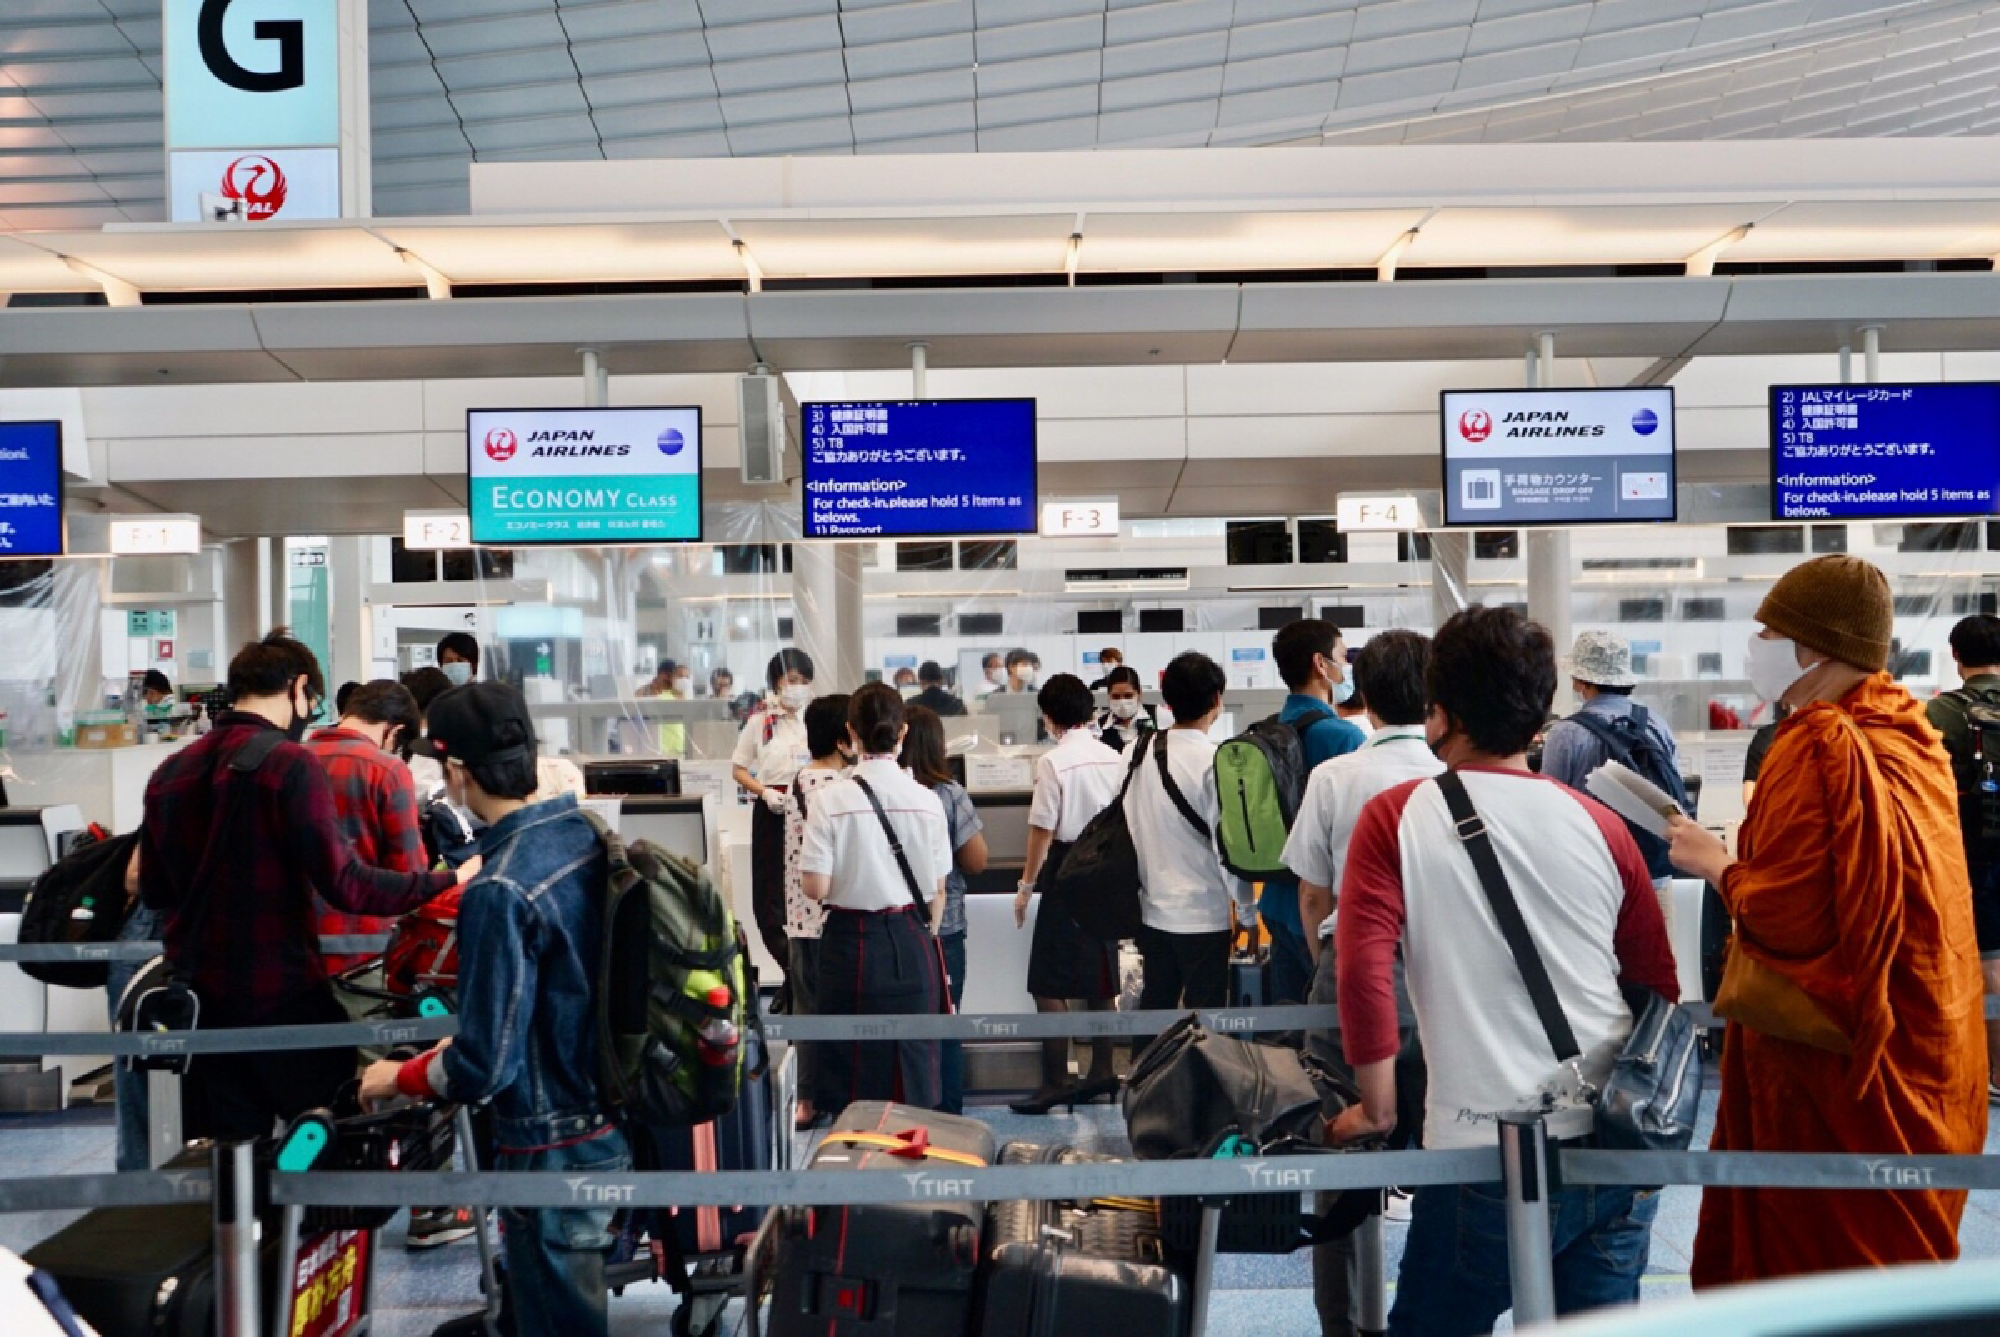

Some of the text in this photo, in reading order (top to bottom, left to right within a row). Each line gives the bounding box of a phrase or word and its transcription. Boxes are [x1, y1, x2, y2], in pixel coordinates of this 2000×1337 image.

[197, 0, 304, 92] G
[1502, 411, 1570, 423] JAPAN
[527, 430, 595, 442] JAPAN
[1507, 425, 1606, 438] AIRLINES
[531, 445, 632, 457] AIRLINES
[806, 478, 907, 492] <Information>
[1777, 472, 1877, 487] <Information>
[812, 497, 833, 508] For
[930, 494, 959, 507] hold
[962, 495, 969, 507] 5
[972, 494, 1005, 507] items
[1008, 496, 1022, 506] as
[1785, 491, 1804, 503] For
[1900, 488, 1928, 501] hold
[1931, 488, 1938, 500] 5
[1941, 488, 1974, 500] items
[1977, 490, 1990, 500] as
[813, 511, 861, 523] belows.
[1360, 505, 1398, 523] F-4
[1785, 505, 1831, 517] belows.
[1062, 509, 1101, 528] F-3
[423, 522, 461, 542] F-2
[983, 1023, 1018, 1035] TIAT
[1219, 1017, 1257, 1029] TIAT
[382, 1028, 418, 1039] TIAT
[1259, 1168, 1314, 1186] TIAT
[1882, 1166, 1934, 1185] TIAT
[582, 1185, 635, 1201] TIAT
[922, 1180, 974, 1196] TIAT
